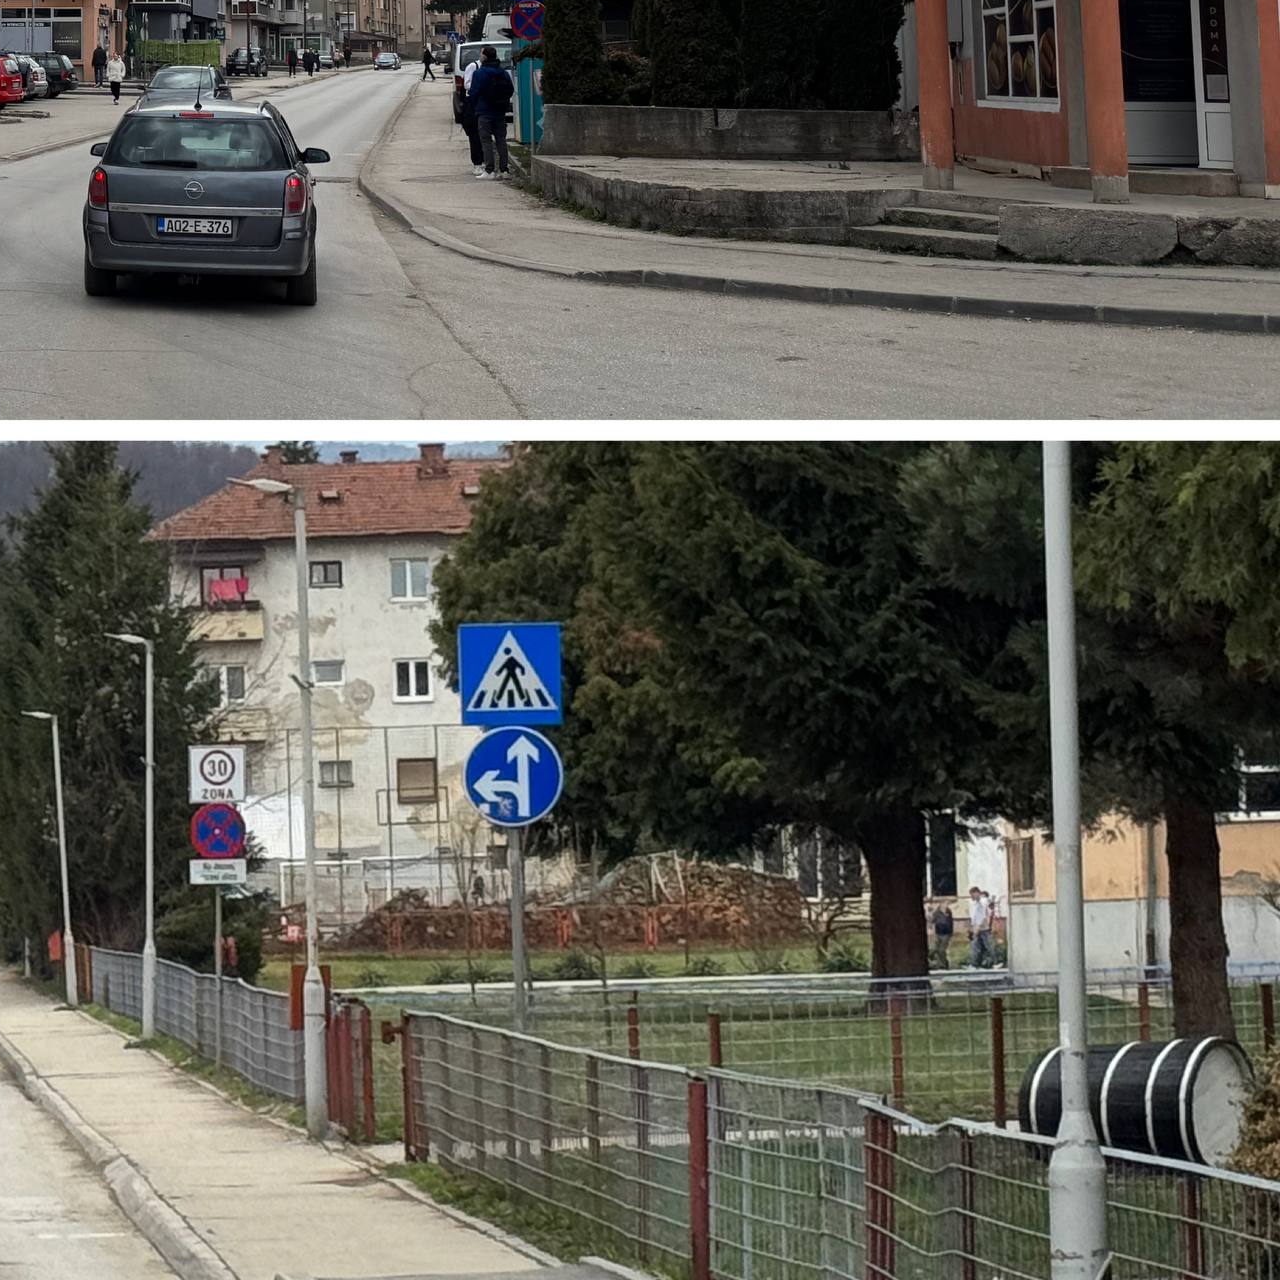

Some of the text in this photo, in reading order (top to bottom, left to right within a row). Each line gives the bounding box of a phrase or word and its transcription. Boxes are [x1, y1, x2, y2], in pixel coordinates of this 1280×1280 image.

[1209, 7, 1220, 52] DOMA
[166, 220, 230, 234] A02-E-376
[207, 759, 228, 777] 30
[201, 788, 234, 800] ZONA
